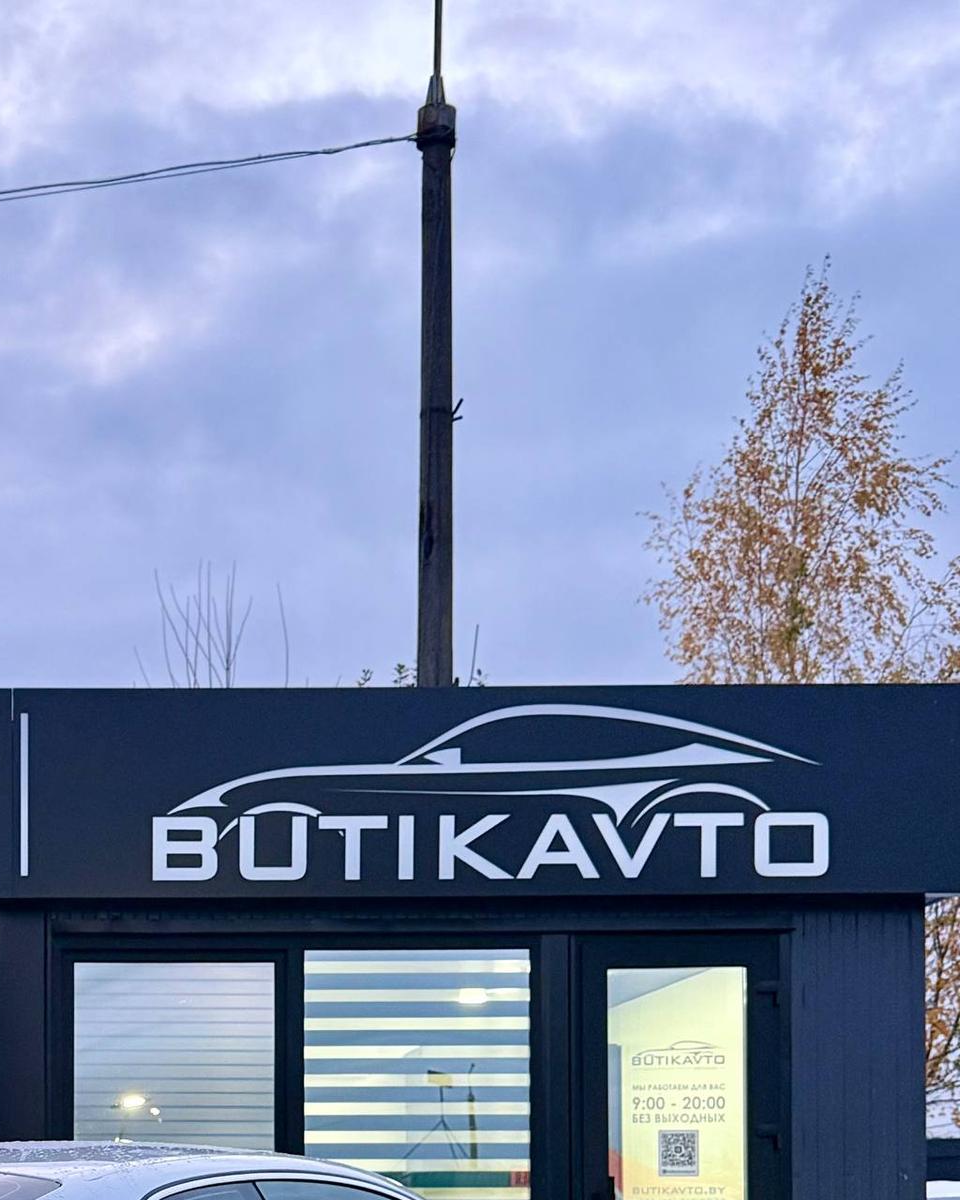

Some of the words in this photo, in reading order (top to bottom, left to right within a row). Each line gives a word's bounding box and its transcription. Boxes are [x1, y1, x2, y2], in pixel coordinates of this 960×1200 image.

[152, 812, 830, 881] BUTIKAVTO
[632, 1055, 725, 1066] BUTIKAVTO
[709, 1083, 726, 1091] ВАС
[632, 1096, 665, 1110] 9:00
[682, 1096, 725, 1110] 20:00
[632, 1113, 651, 1123] БЕЗ
[655, 1113, 725, 1124] ВЫХОДНЫХ
[632, 1186, 725, 1195] BUTIKAVTO.BY
